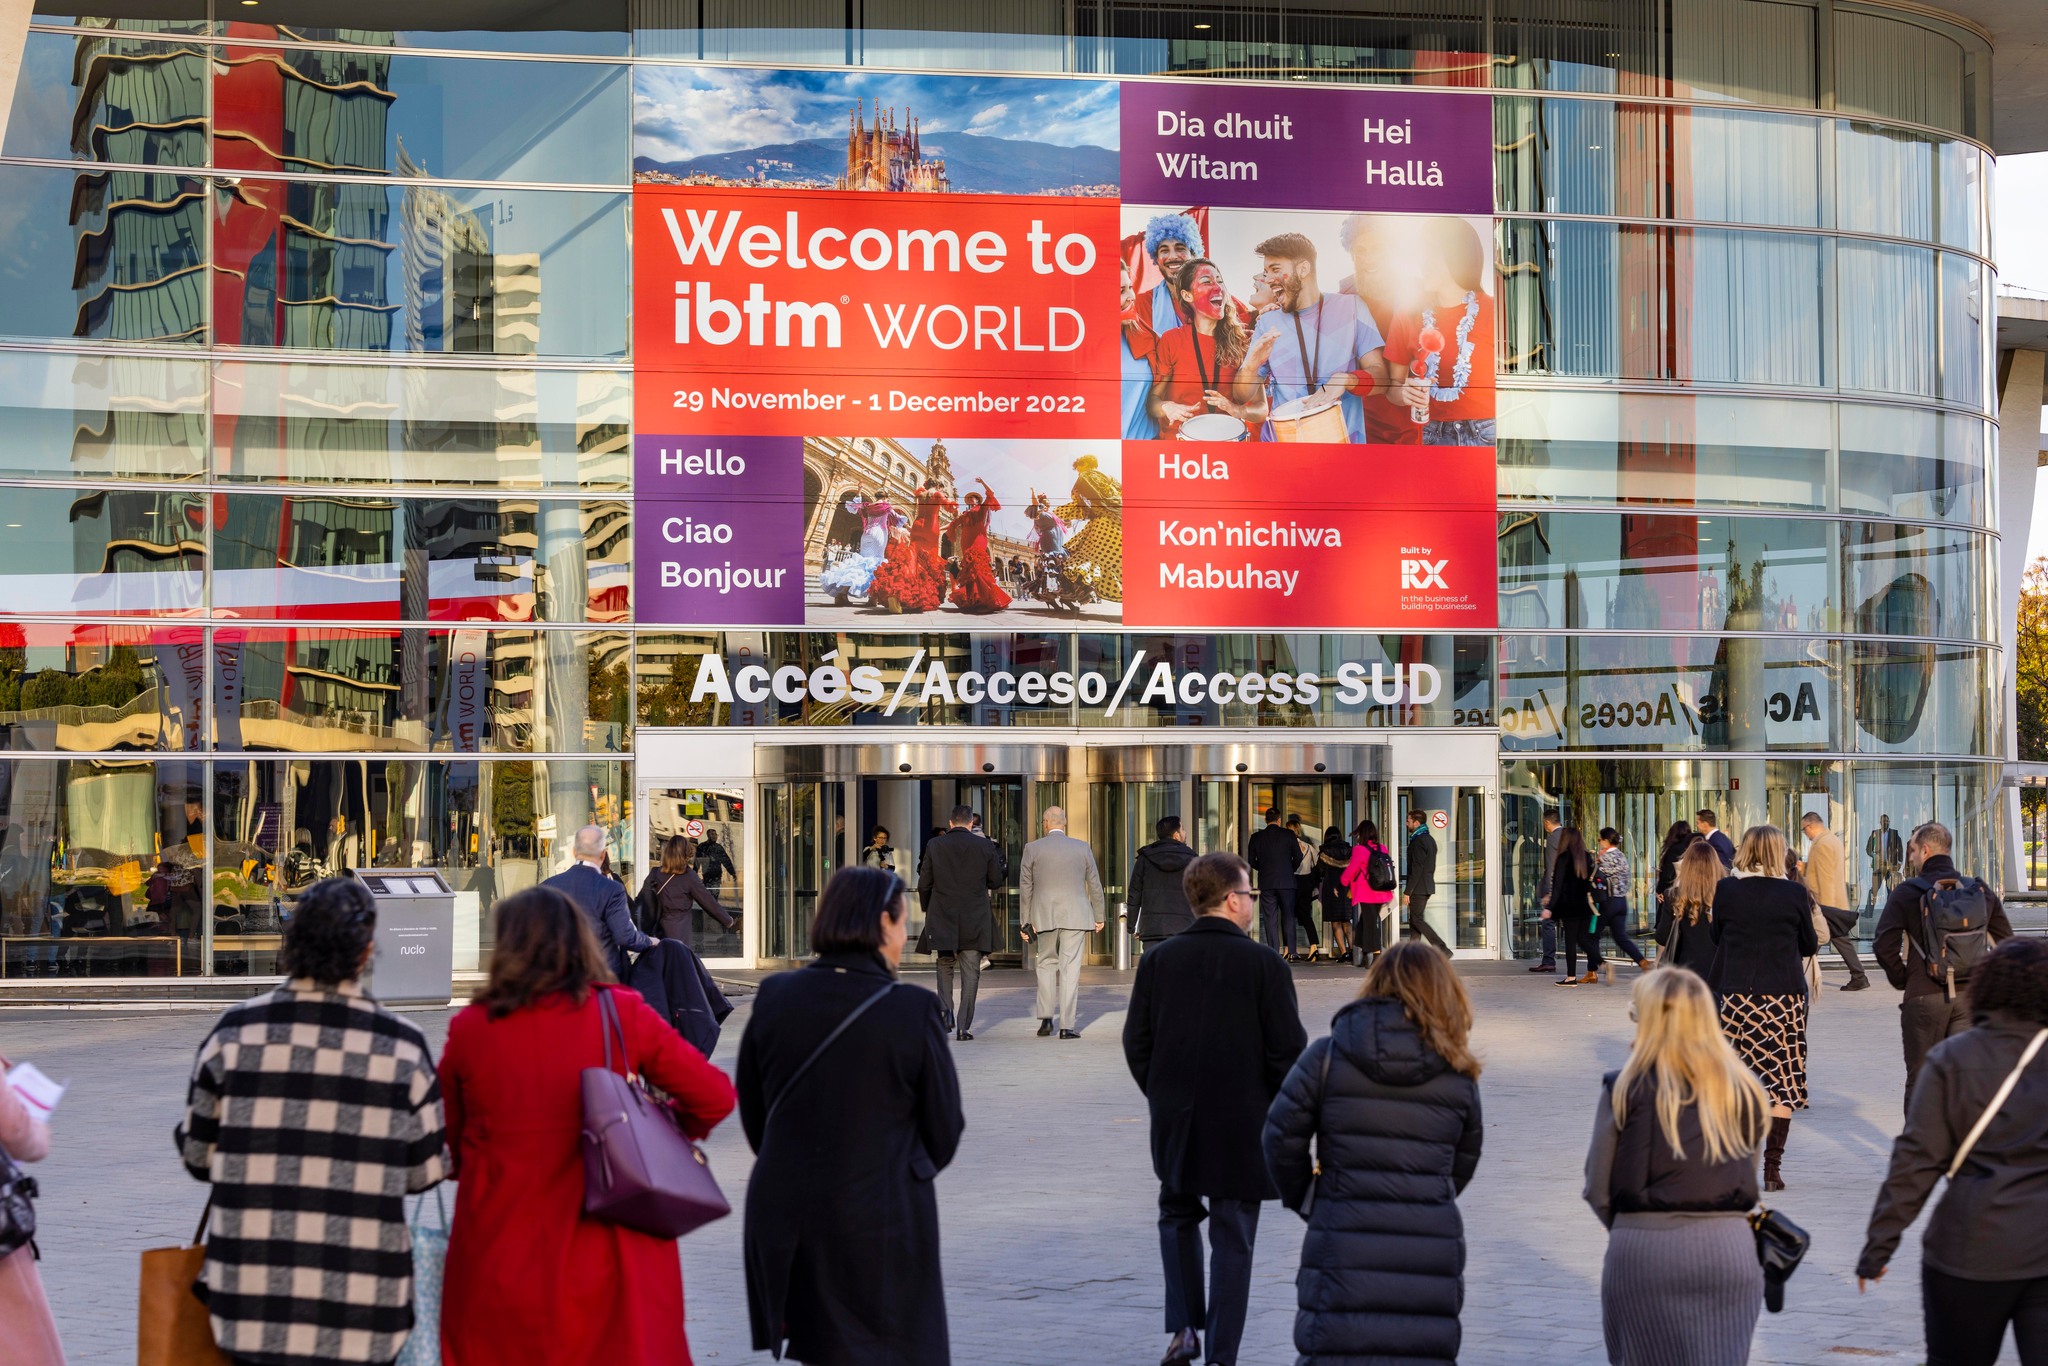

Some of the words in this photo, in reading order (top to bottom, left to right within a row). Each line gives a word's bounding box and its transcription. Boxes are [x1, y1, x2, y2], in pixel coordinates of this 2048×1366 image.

[1157, 110, 1206, 137] Dia
[1213, 112, 1294, 140] dhuit
[1363, 118, 1412, 145] Hei
[1155, 152, 1258, 181] Witam
[1366, 160, 1444, 187] Hallå
[661, 208, 1007, 274] Welcome
[1026, 219, 1097, 276] to
[863, 303, 1086, 352] WORLD
[673, 390, 704, 413] 29
[711, 387, 846, 411] November
[868, 393, 882, 411] 1
[889, 390, 1020, 413] December
[1026, 395, 1086, 413] 2022
[660, 448, 746, 476] Hello
[1159, 453, 1230, 480] Hola
[661, 516, 733, 544] Ciao
[1400, 546, 1421, 555] Built
[1421, 546, 1432, 556] by
[660, 561, 787, 595] Bonjour
[1159, 562, 1299, 597] Mabuhay
[1401, 559, 1449, 590] RX
[1401, 594, 1409, 603] In
[1410, 594, 1424, 603] the
[1425, 594, 1459, 603] business
[1460, 594, 1469, 603] of
[1401, 602, 1434, 611] building
[1435, 602, 1477, 610] businesses
[1335, 662, 1442, 705] SUD
